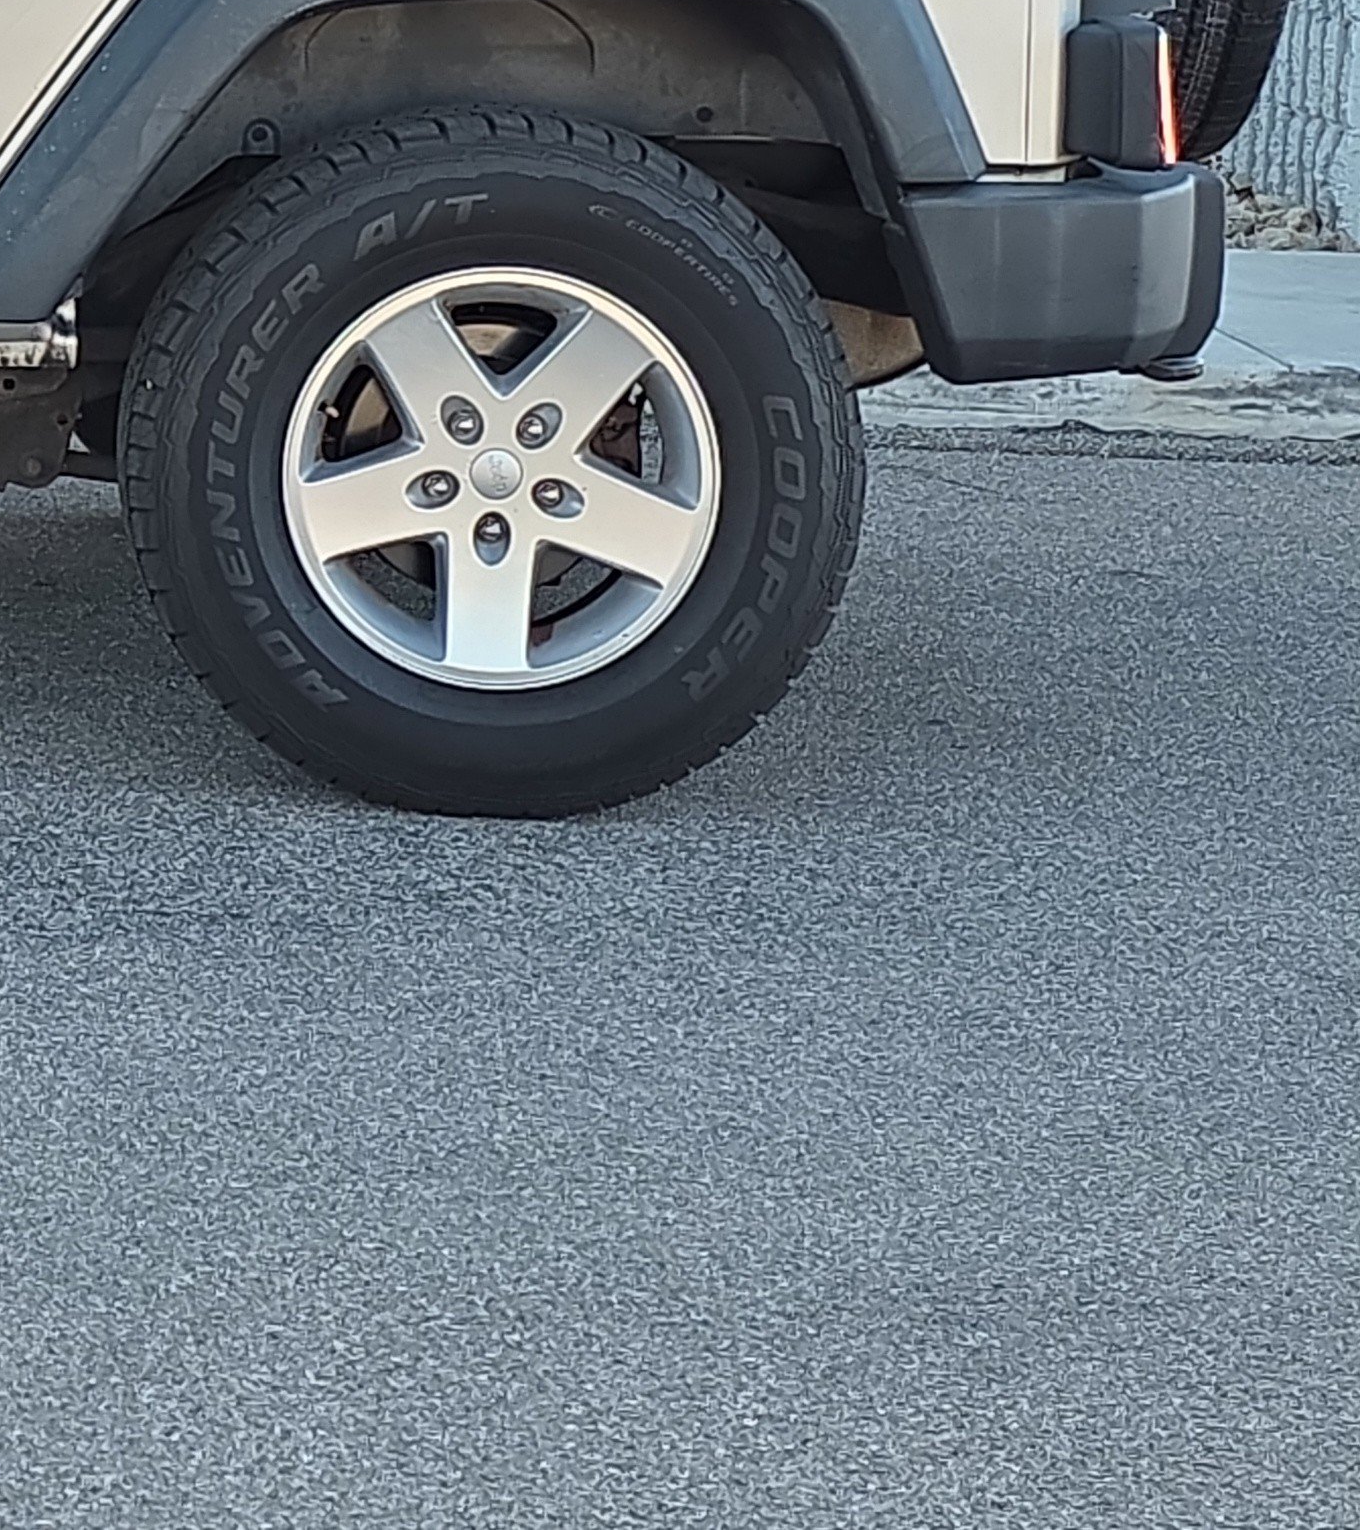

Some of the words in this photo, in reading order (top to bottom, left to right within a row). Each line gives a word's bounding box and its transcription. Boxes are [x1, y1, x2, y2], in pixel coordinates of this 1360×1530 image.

[205, 261, 351, 713] ADVENTURER
[353, 192, 490, 262] A/T
[680, 394, 807, 703] COOPER
